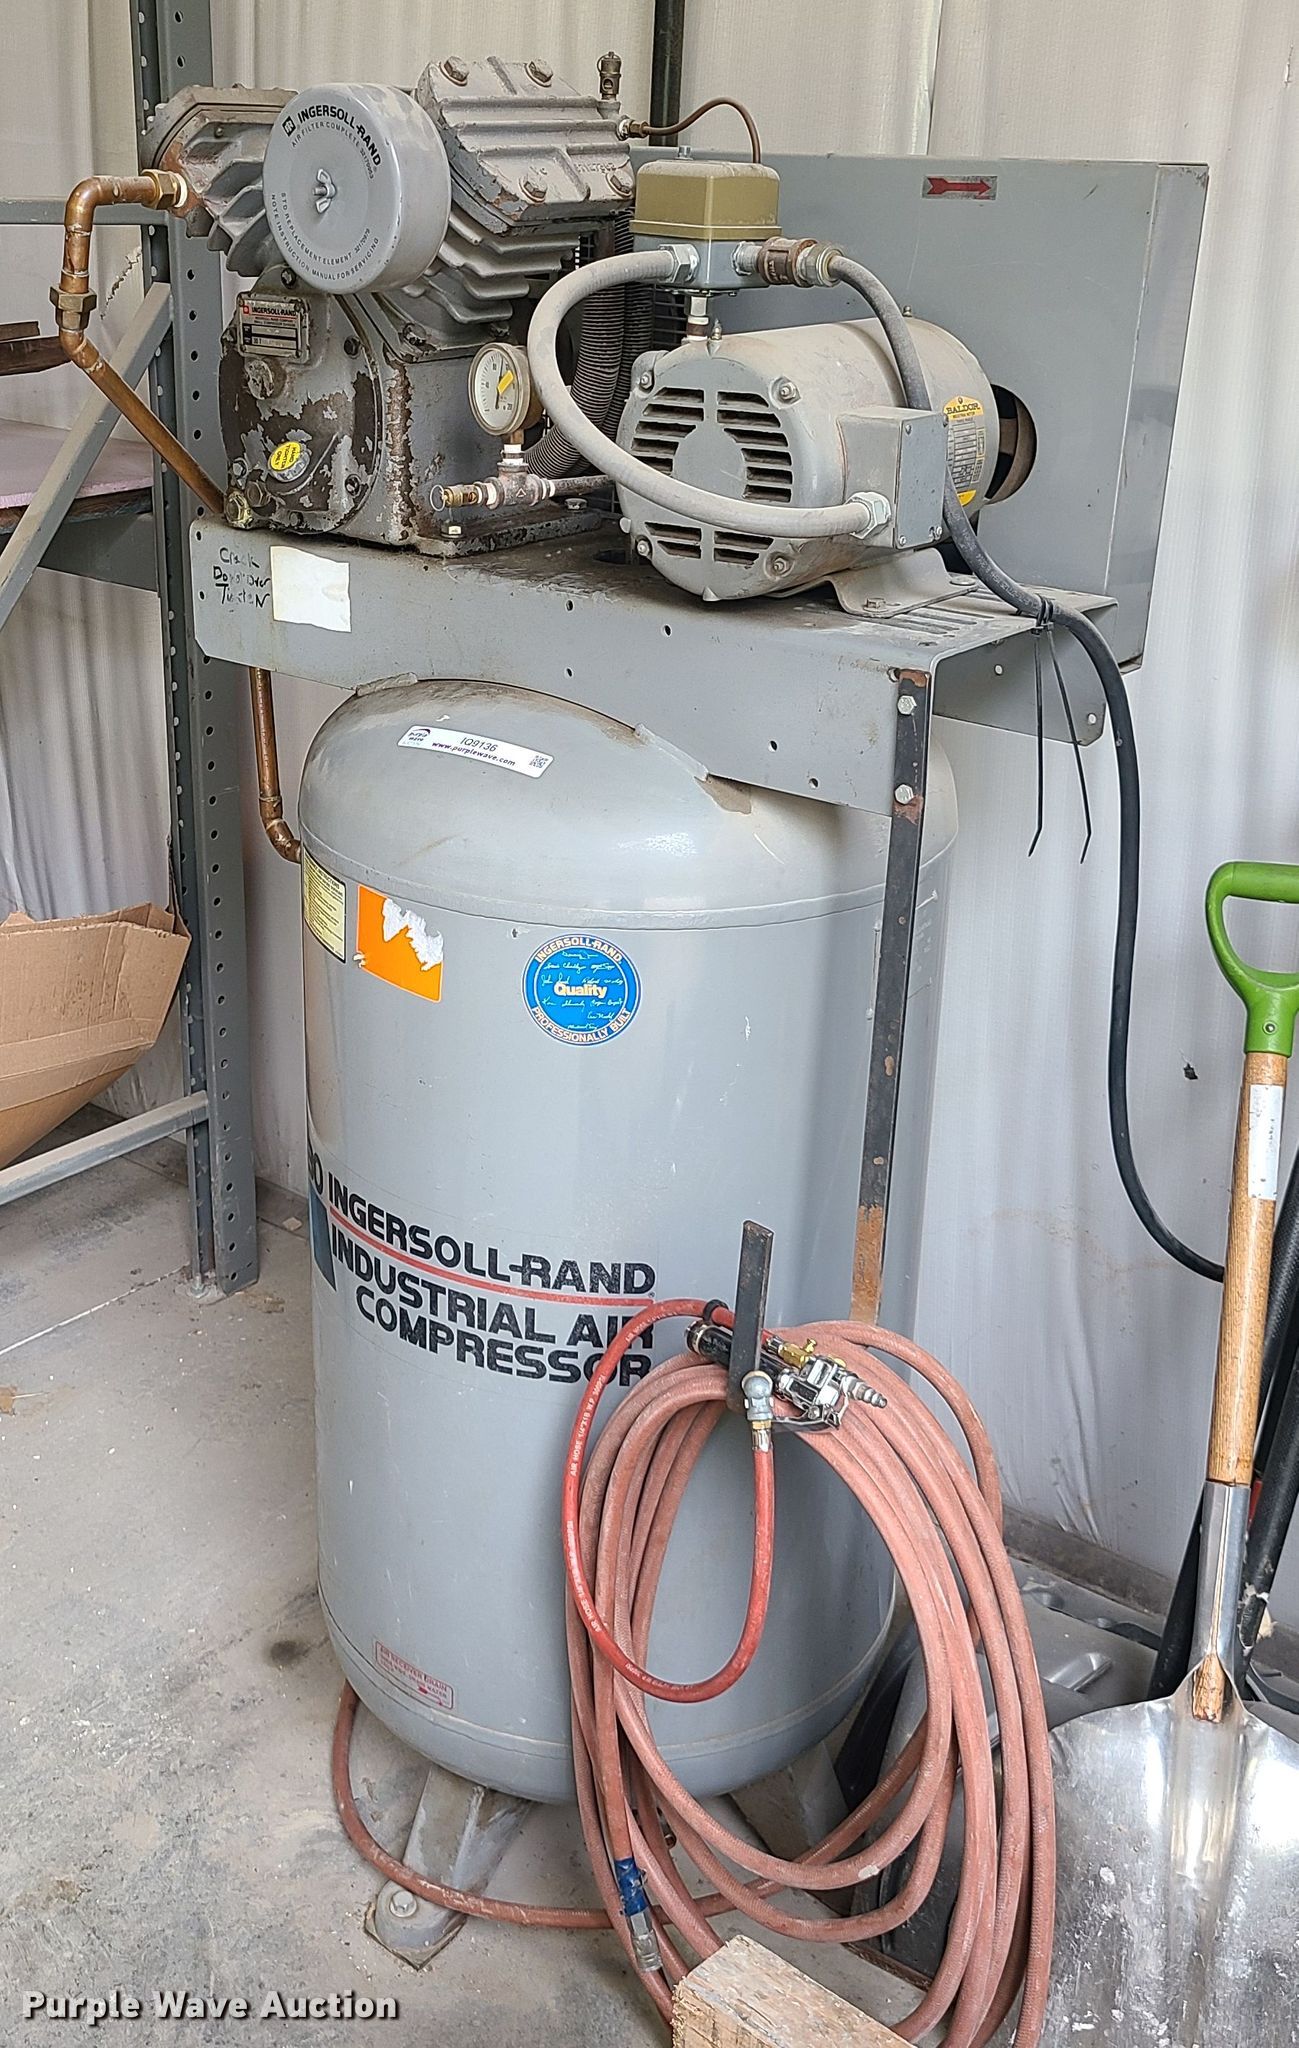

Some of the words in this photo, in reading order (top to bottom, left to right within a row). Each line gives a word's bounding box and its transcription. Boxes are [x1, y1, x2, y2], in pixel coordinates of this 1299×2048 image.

[292, 134, 302, 147] AIR
[301, 122, 324, 136] FILTER
[326, 121, 360, 147] COMPLETE
[298, 105, 381, 166] INGERSOLL-RAND
[271, 194, 279, 219] NOTE
[276, 221, 310, 272] INSTRUCTION
[312, 269, 336, 281] MANUAL
[336, 271, 350, 279] FOR
[350, 237, 379, 275] SERVICING
[285, 213, 321, 262] REPLACEMENT
[322, 252, 352, 265] ELEMENT
[252, 306, 297, 316] INGERSOLL-RAND
[946, 402, 981, 414] BALDOR
[432, 741, 516, 766] www.purplewave.com
[460, 737, 498, 752] IQ9136
[535, 937, 622, 963] INGERSOLL-RAND
[553, 983, 607, 998] Quality
[532, 1006, 608, 1042] PROFESSIONALLY
[611, 1008, 631, 1032] BUILT
[328, 1171, 656, 1295] INGERSOLL-RAND
[331, 1223, 556, 1344] INDUSTRIAL
[356, 1285, 653, 1387] COMPRESSOR
[572, 1440, 583, 1461] HOSE
[570, 1462, 578, 1477] AIR
[580, 1599, 593, 1620] HOSE
[590, 1619, 601, 1633] AIR
